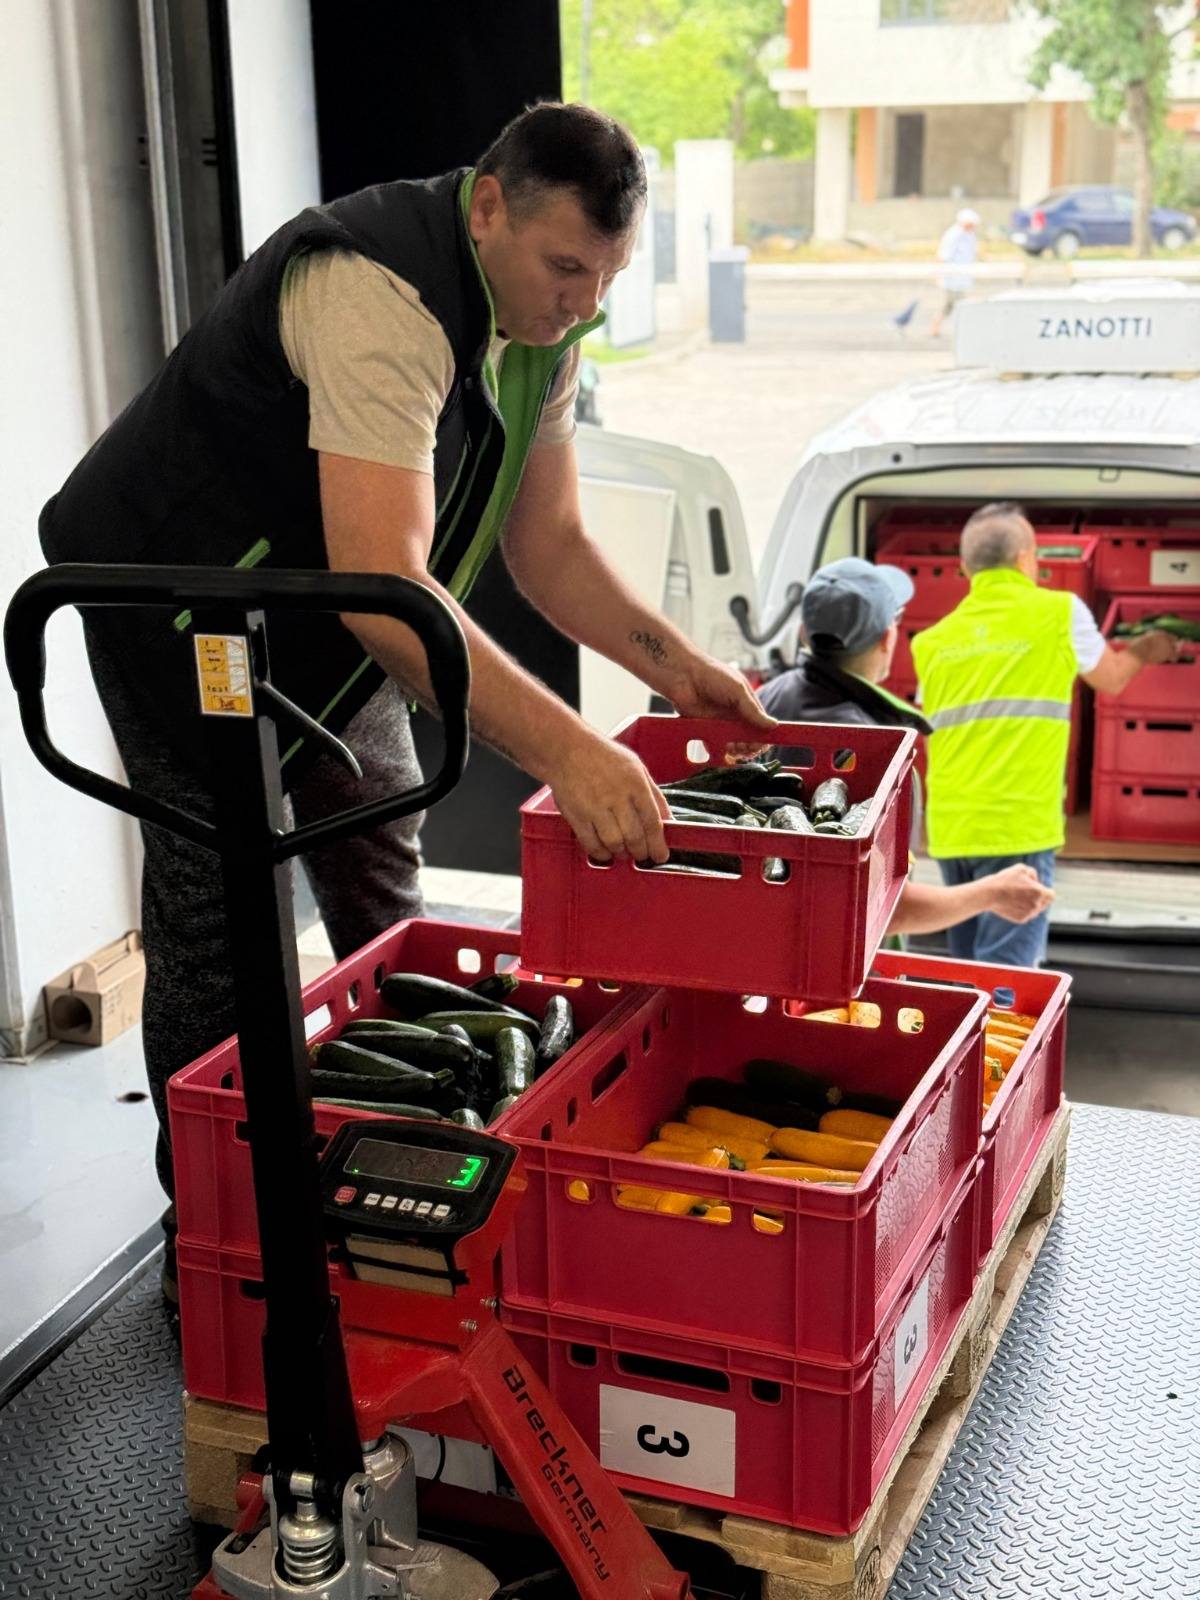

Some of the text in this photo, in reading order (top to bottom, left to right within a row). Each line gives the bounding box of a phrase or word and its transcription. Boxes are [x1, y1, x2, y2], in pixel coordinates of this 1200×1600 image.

[1039, 317, 1151, 338] ZANOTTI
[903, 1323, 918, 1365] 3
[502, 1364, 608, 1534] Breckner
[637, 1424, 690, 1458] 3
[541, 1463, 610, 1581] Germany
